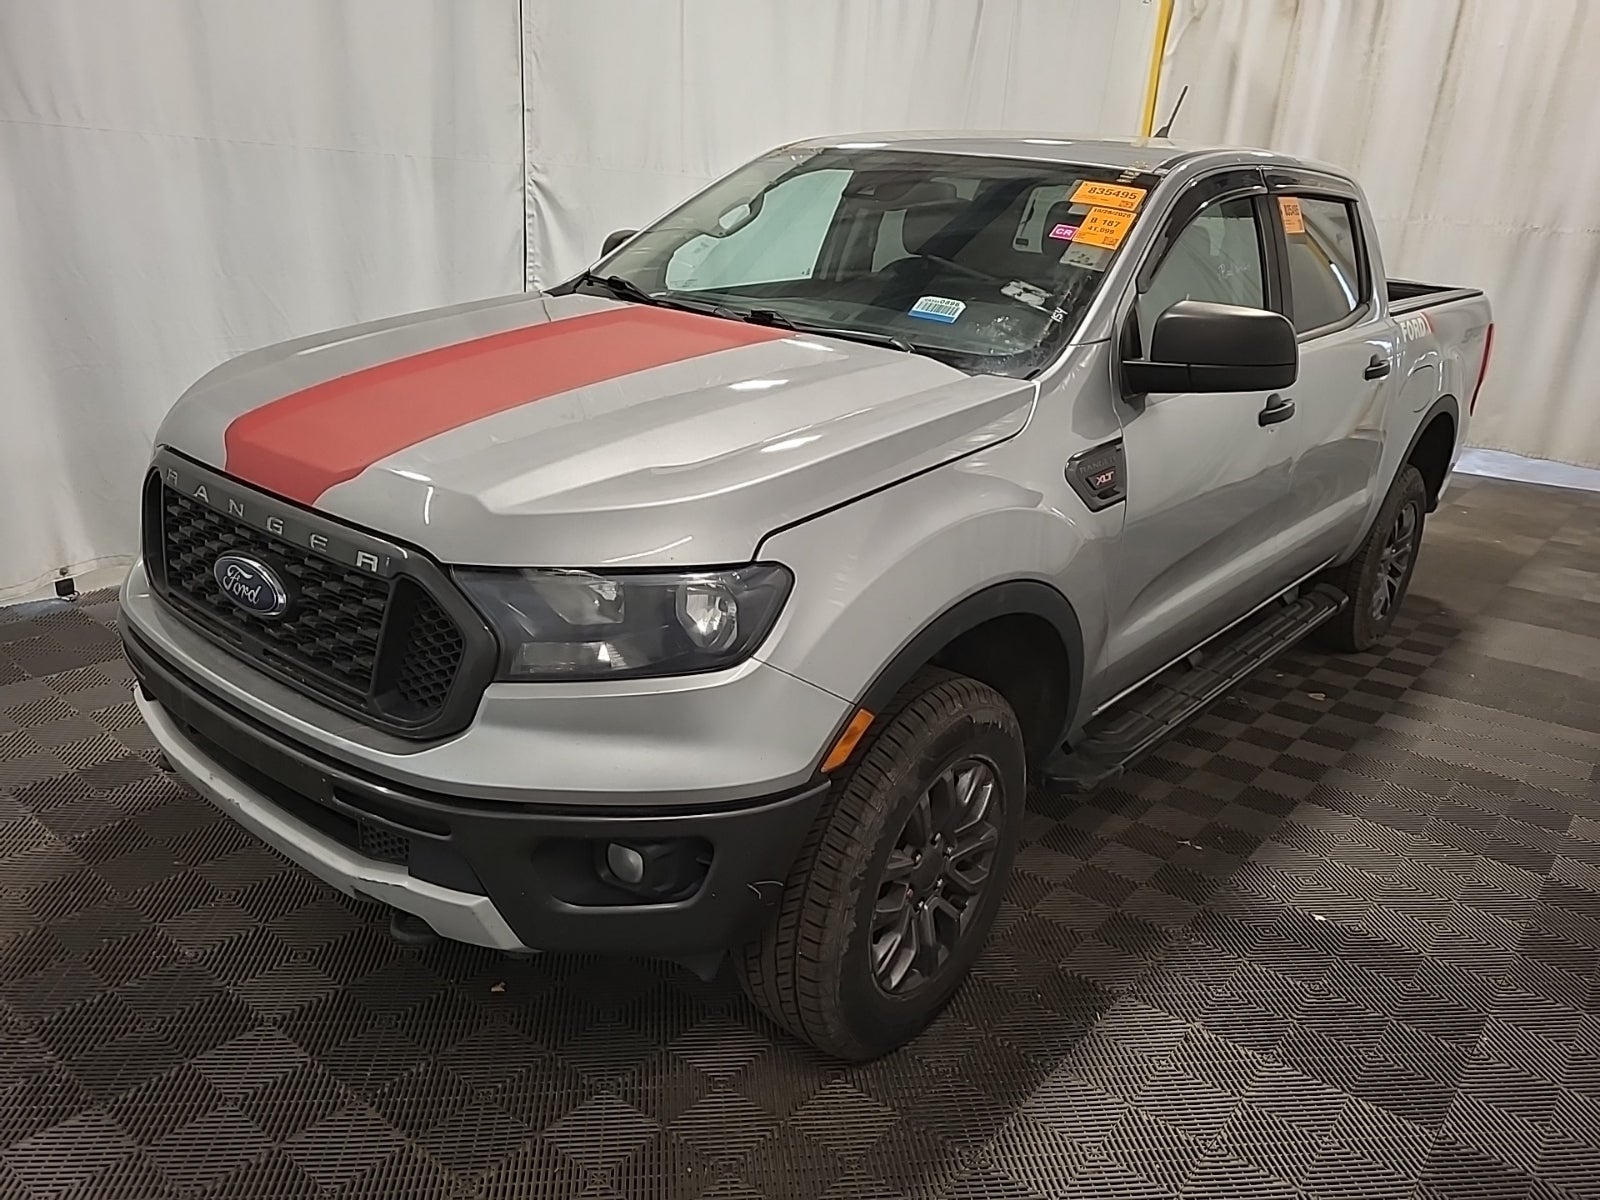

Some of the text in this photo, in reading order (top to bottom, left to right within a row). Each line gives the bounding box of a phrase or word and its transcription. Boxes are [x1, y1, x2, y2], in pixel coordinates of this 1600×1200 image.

[1088, 187, 1137, 200] 835495
[1055, 228, 1073, 237] CR
[1400, 317, 1427, 343] FORD
[1096, 470, 1115, 486] XLT
[166, 468, 379, 573] RANGER
[223, 564, 262, 604] Ford
